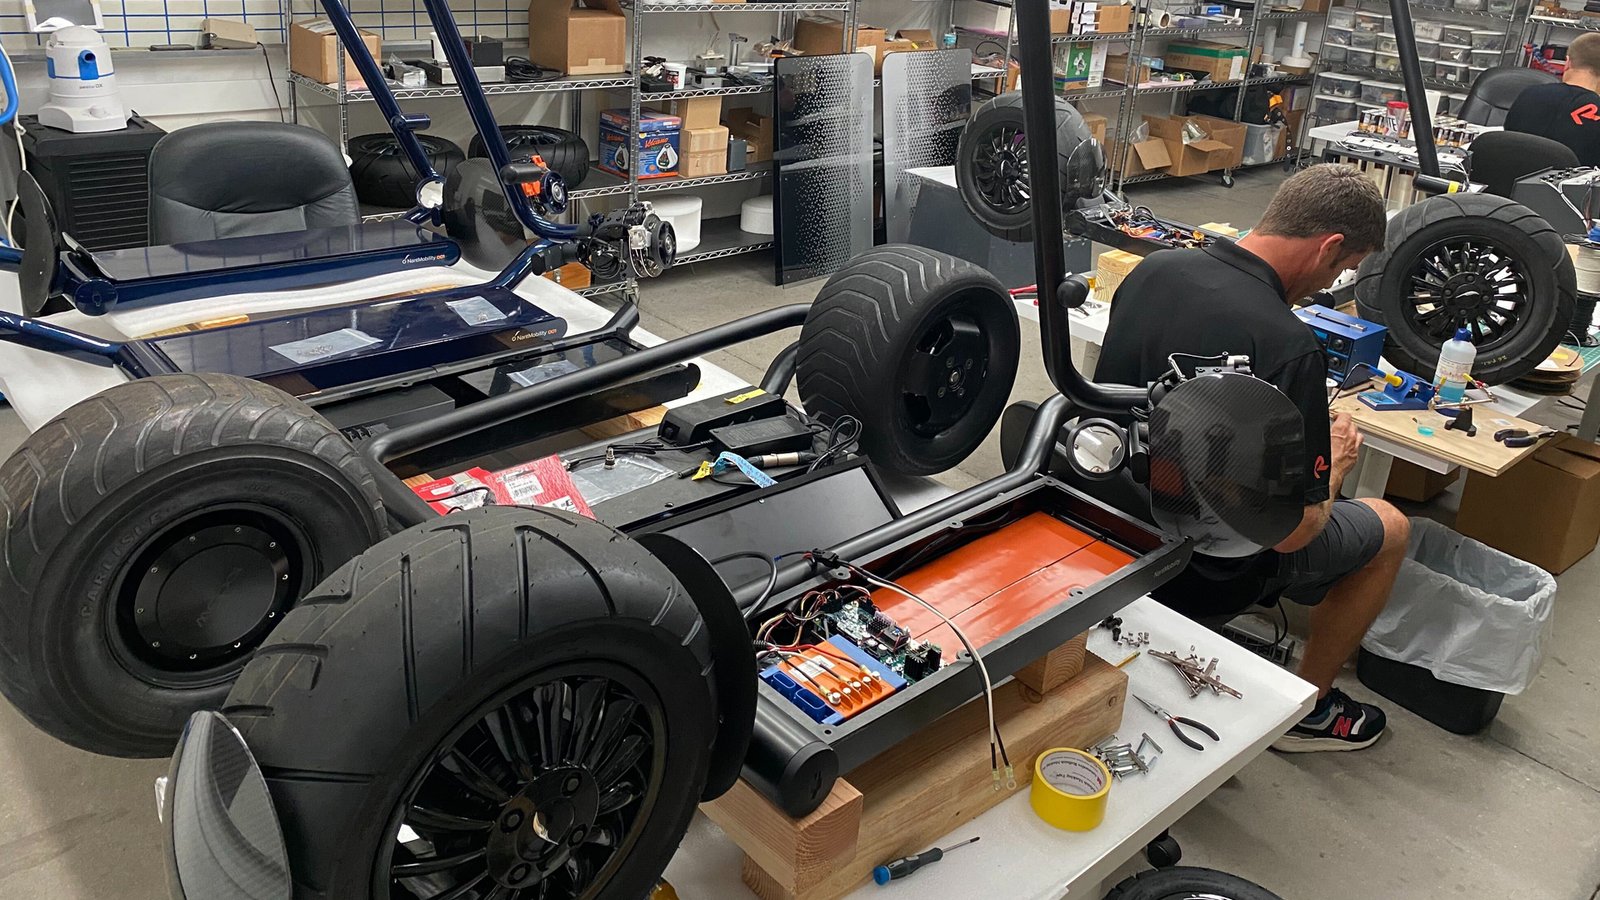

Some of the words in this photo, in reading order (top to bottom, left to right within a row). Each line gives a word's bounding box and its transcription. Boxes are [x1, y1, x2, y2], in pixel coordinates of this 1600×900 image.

[516, 330, 547, 341] NantMobility
[80, 509, 163, 619] CARLISLE
[1331, 715, 1353, 738] N
